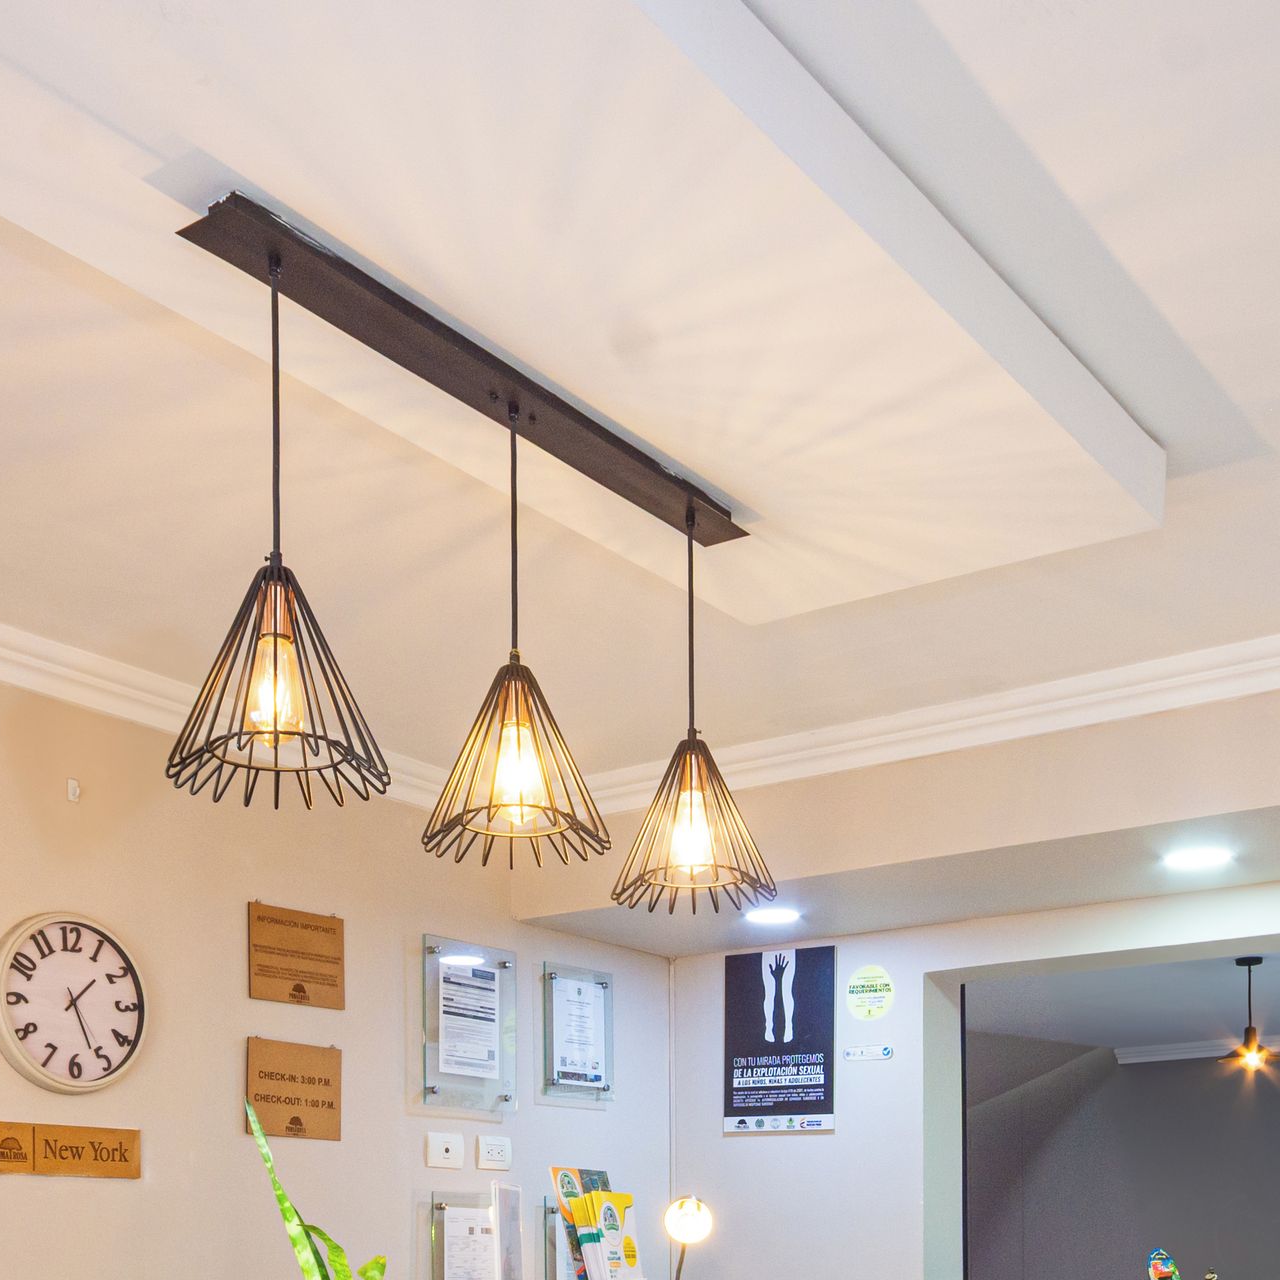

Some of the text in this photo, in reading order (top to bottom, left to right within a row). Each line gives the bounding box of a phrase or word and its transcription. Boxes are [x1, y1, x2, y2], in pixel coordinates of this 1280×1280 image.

[29, 929, 56, 960] 11
[59, 925, 83, 953] 12
[89, 939, 105, 963] 1
[9, 951, 37, 982] 10
[105, 966, 129, 984] 2
[6, 991, 29, 1006] 9
[114, 1000, 138, 1013] 3
[14, 1022, 38, 1041] 8
[111, 1028, 133, 1048] 4
[41, 1042, 58, 1068] 7
[94, 1045, 112, 1072] 5
[733, 1053, 824, 1067] CON TU MIRADA PROTEGEMOS
[68, 1053, 82, 1079] 6
[733, 1064, 824, 1078] DE LA EXPLOTACIÓN SEXUAL
[258, 1070, 332, 1087] CHECK-IN: 3:00 P.M.
[741, 1078, 751, 1086] LOS
[254, 1093, 335, 1110] CHECK-OUT: 1:00 P.M.
[43, 1138, 129, 1163] New York
